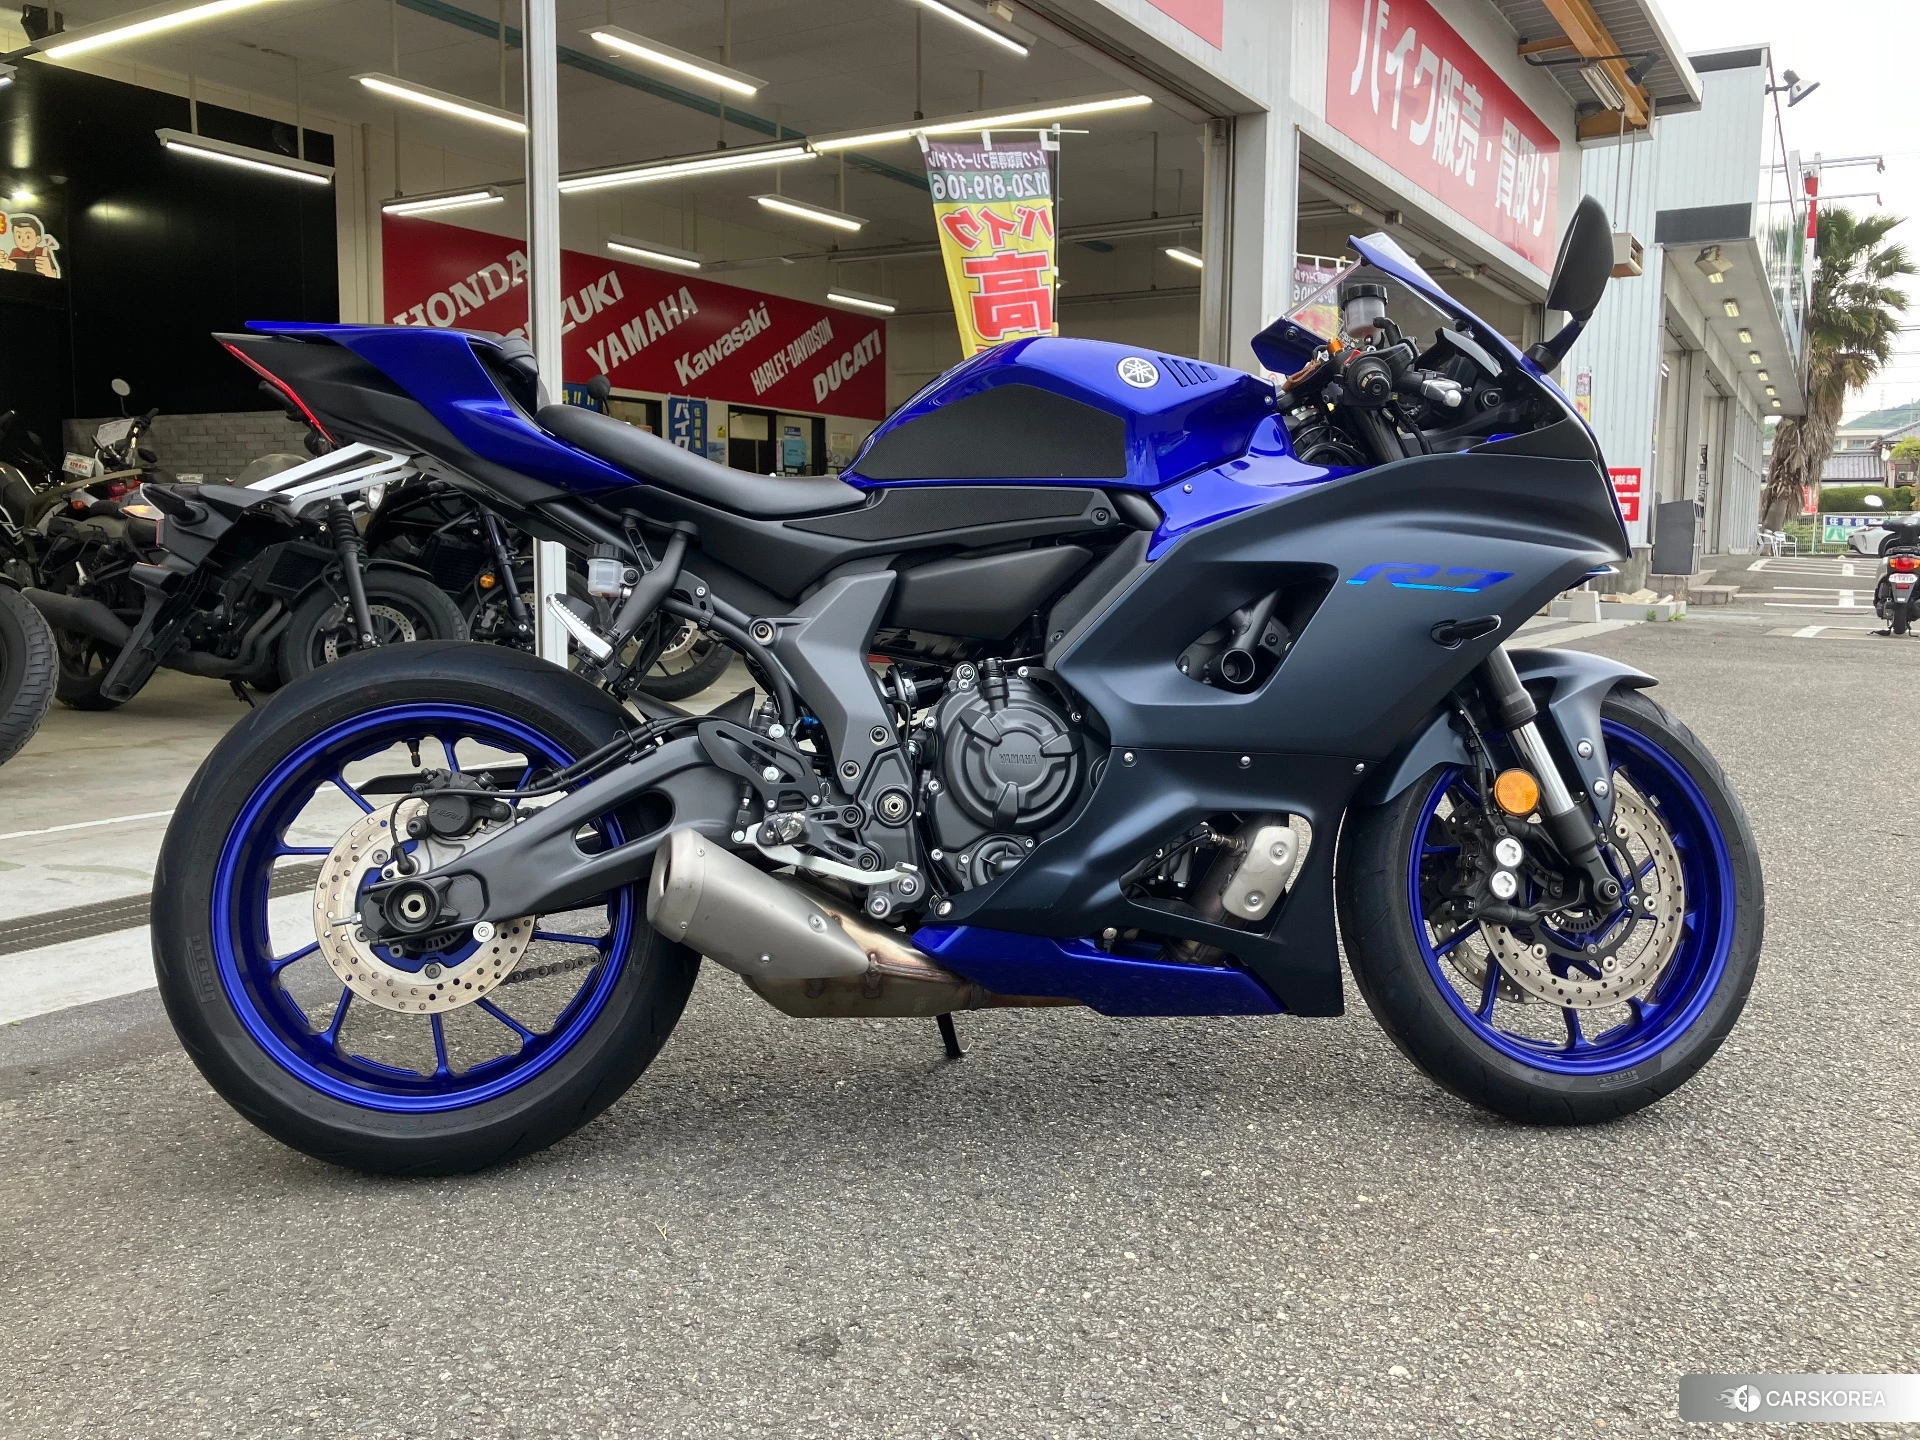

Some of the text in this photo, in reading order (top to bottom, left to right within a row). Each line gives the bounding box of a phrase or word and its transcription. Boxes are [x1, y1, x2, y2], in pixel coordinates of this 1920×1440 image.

[586, 286, 699, 376] YAMAHA
[674, 301, 771, 387] Kawasaki
[750, 316, 834, 396] HARLEY-DAVIDSON
[812, 329, 882, 404] DUCATI
[1345, 562, 1516, 593] R7
[999, 753, 1037, 765] YAMAHA
